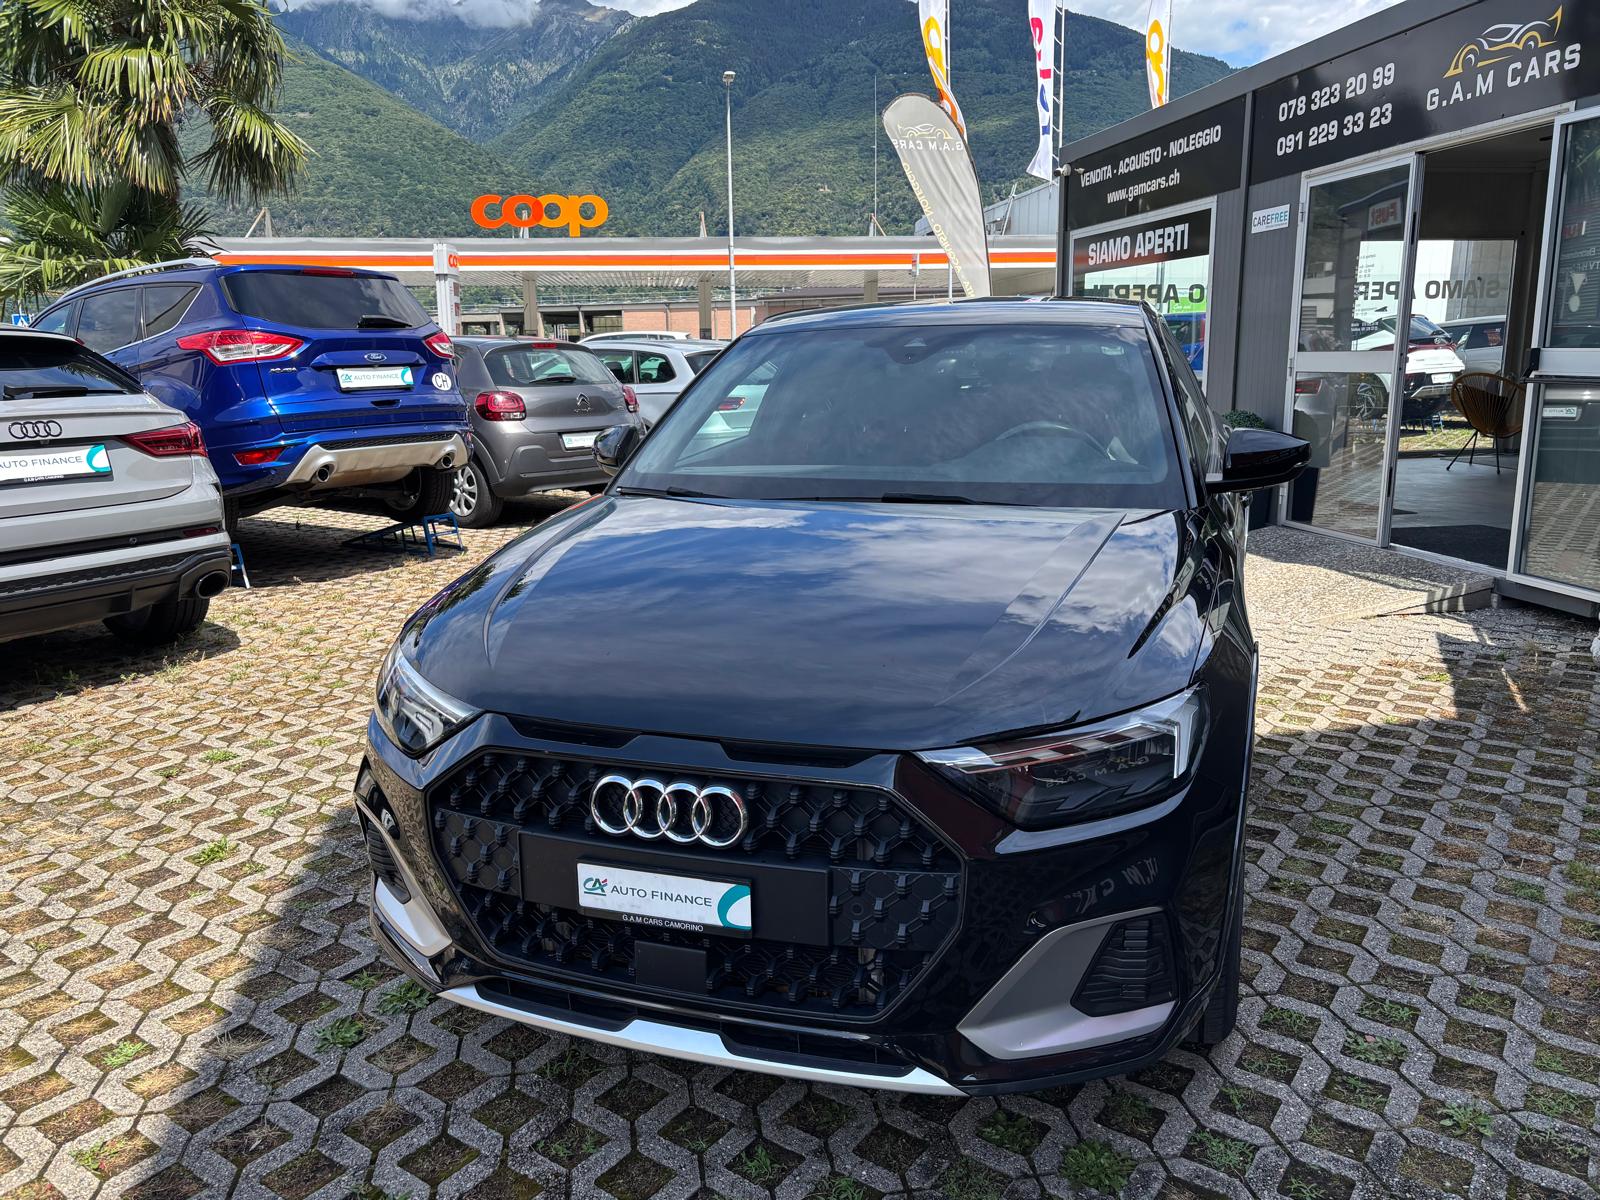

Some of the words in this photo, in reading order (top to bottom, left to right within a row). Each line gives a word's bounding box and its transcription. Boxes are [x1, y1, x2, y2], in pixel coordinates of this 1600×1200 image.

[1279, 95, 1306, 122] 078
[1311, 83, 1340, 111] 323
[1346, 72, 1367, 99] 20
[1372, 62, 1395, 90] 99
[1426, 70, 1494, 111] G.A.M
[1506, 43, 1581, 88] CARS
[1277, 131, 1303, 157] 091
[1308, 119, 1338, 147] 229
[1343, 111, 1364, 136] 33
[1369, 102, 1392, 129] 23
[1080, 165, 1112, 188] VENDITA
[1118, 146, 1161, 176] ACQUISTO
[1169, 125, 1221, 158] NOLEGGIO
[1107, 168, 1180, 203] www.gamcars.ch
[470, 194, 609, 237] coop
[1252, 211, 1289, 227] CAREFREE
[1088, 235, 1131, 266] SIAMO
[1134, 223, 1189, 258] APERTI
[434, 374, 449, 388] CH
[31, 456, 83, 466] FINANCE
[611, 885, 647, 898] AUTO
[651, 890, 713, 907] FINANCE
[643, 917, 663, 927] CARS
[664, 920, 704, 932] CAMORINO
